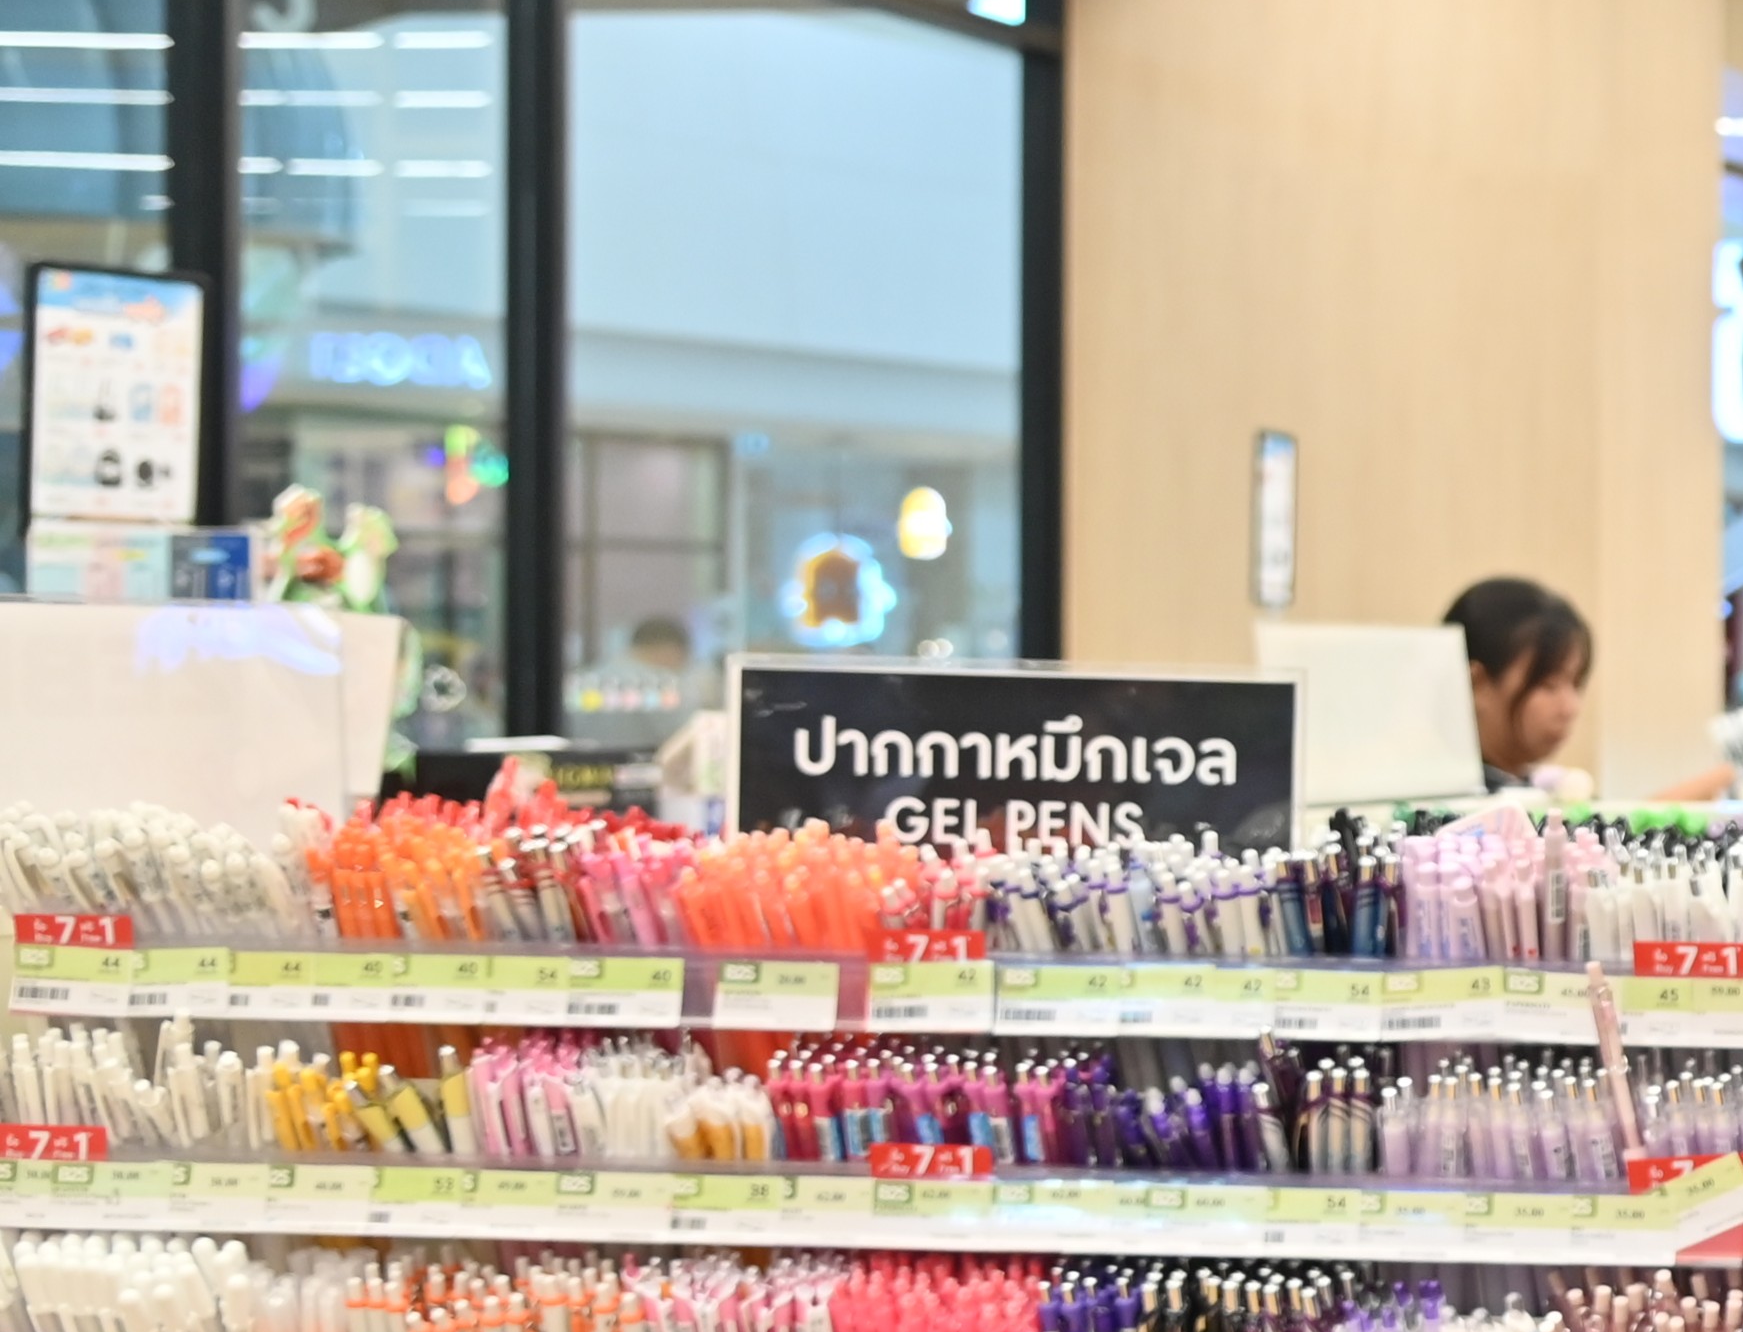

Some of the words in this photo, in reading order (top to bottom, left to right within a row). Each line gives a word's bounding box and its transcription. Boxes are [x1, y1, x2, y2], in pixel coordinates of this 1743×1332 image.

[794, 714, 1238, 787] ปากกาหมึกเจล
[885, 796, 980, 846] GEL
[1005, 800, 1142, 849] PENS
